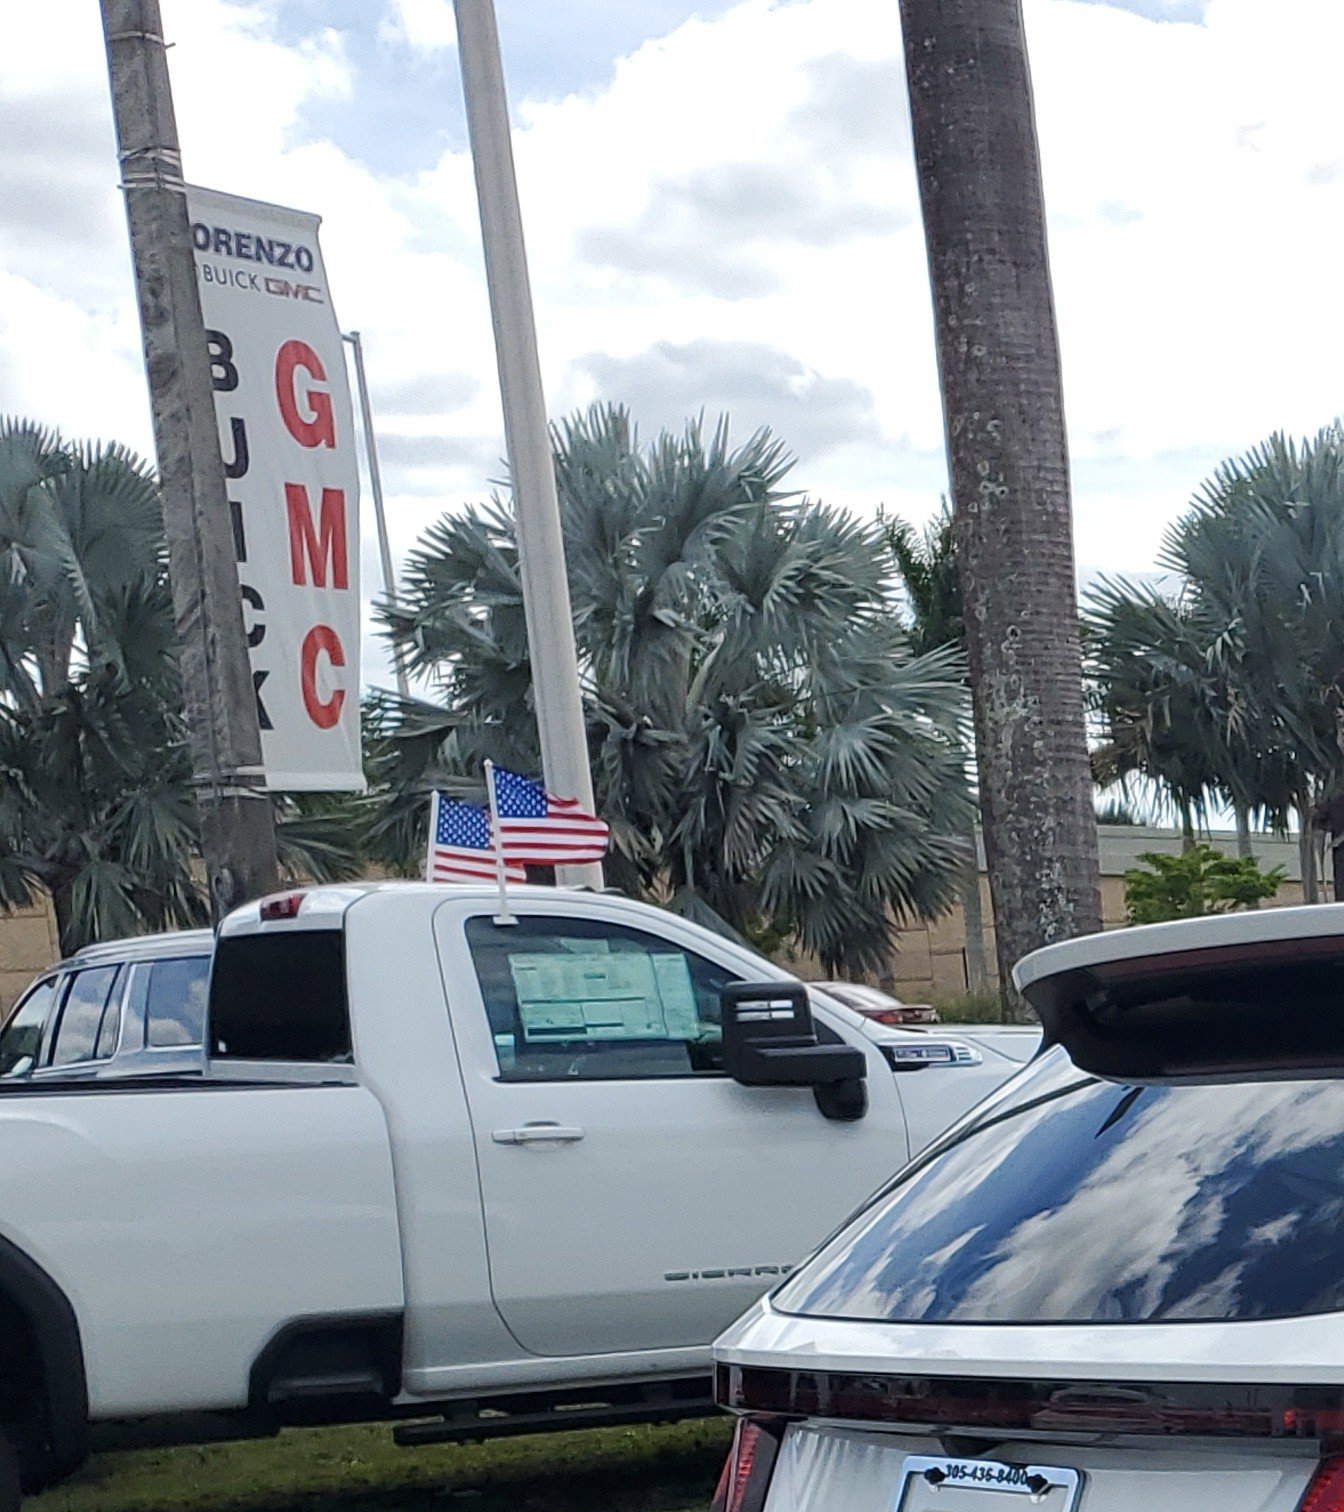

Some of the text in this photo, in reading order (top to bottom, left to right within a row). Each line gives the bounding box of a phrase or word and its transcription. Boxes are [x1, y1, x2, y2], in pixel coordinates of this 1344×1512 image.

[192, 222, 314, 272] ORENZO
[203, 264, 324, 304] BUICK GMC
[275, 339, 348, 729] GMC
